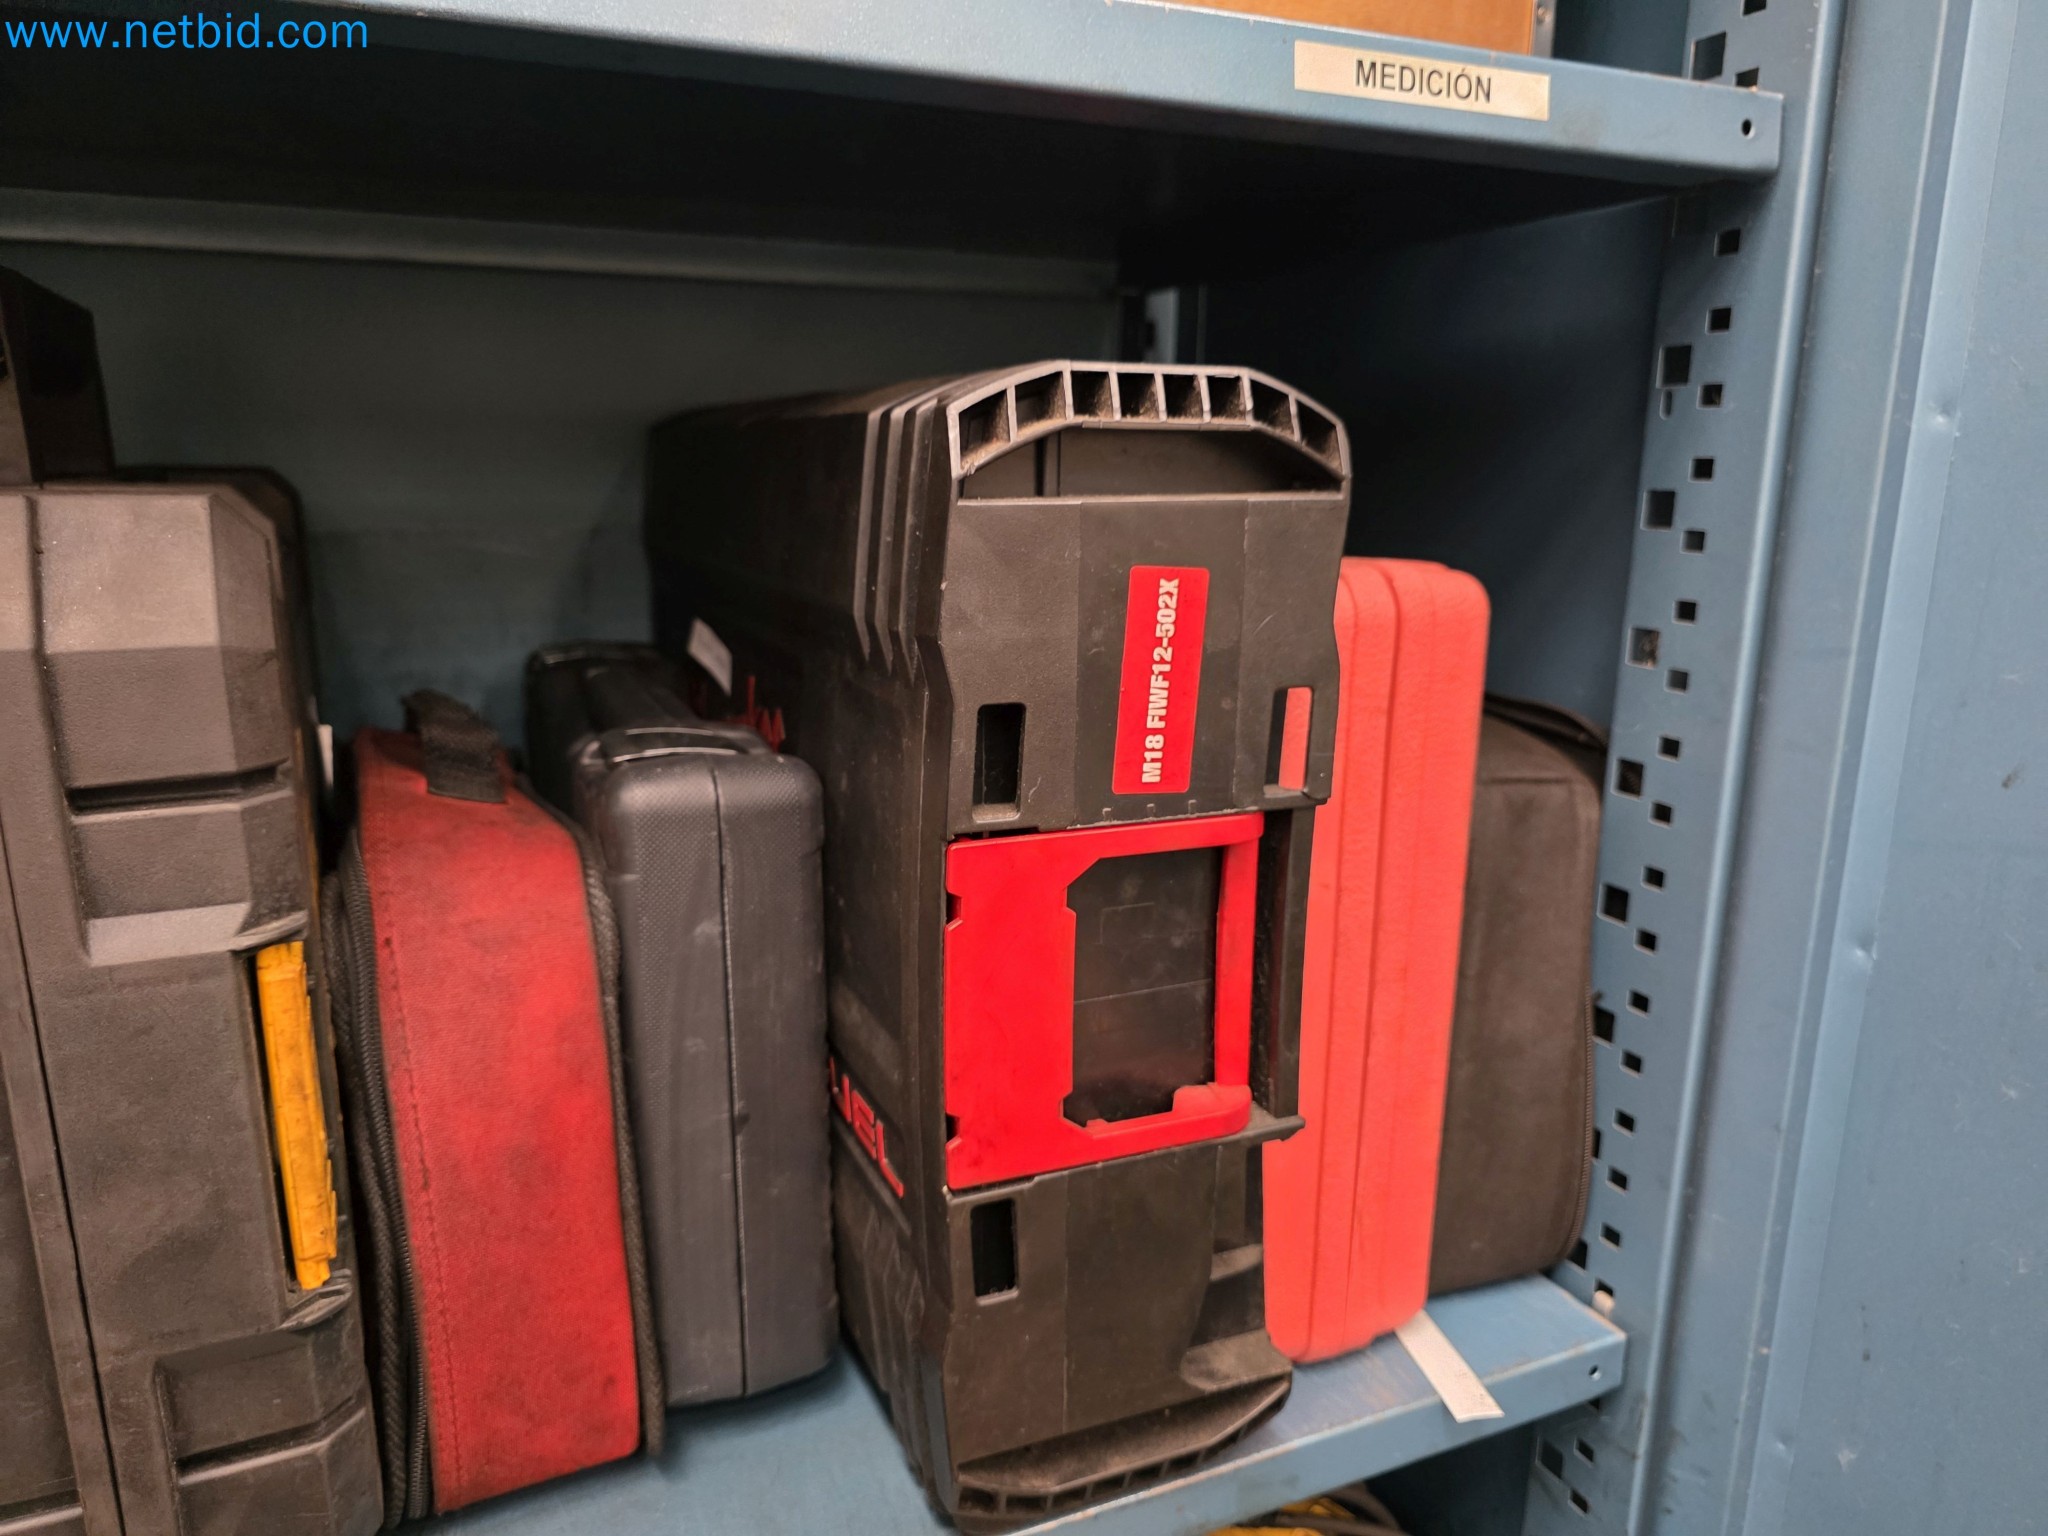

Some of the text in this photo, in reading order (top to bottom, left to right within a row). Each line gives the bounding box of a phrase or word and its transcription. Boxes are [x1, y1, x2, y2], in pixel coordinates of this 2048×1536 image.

[1355, 57, 1492, 103] MEDICIÓN
[1141, 578, 1180, 783] M18 FIWF12-502X
